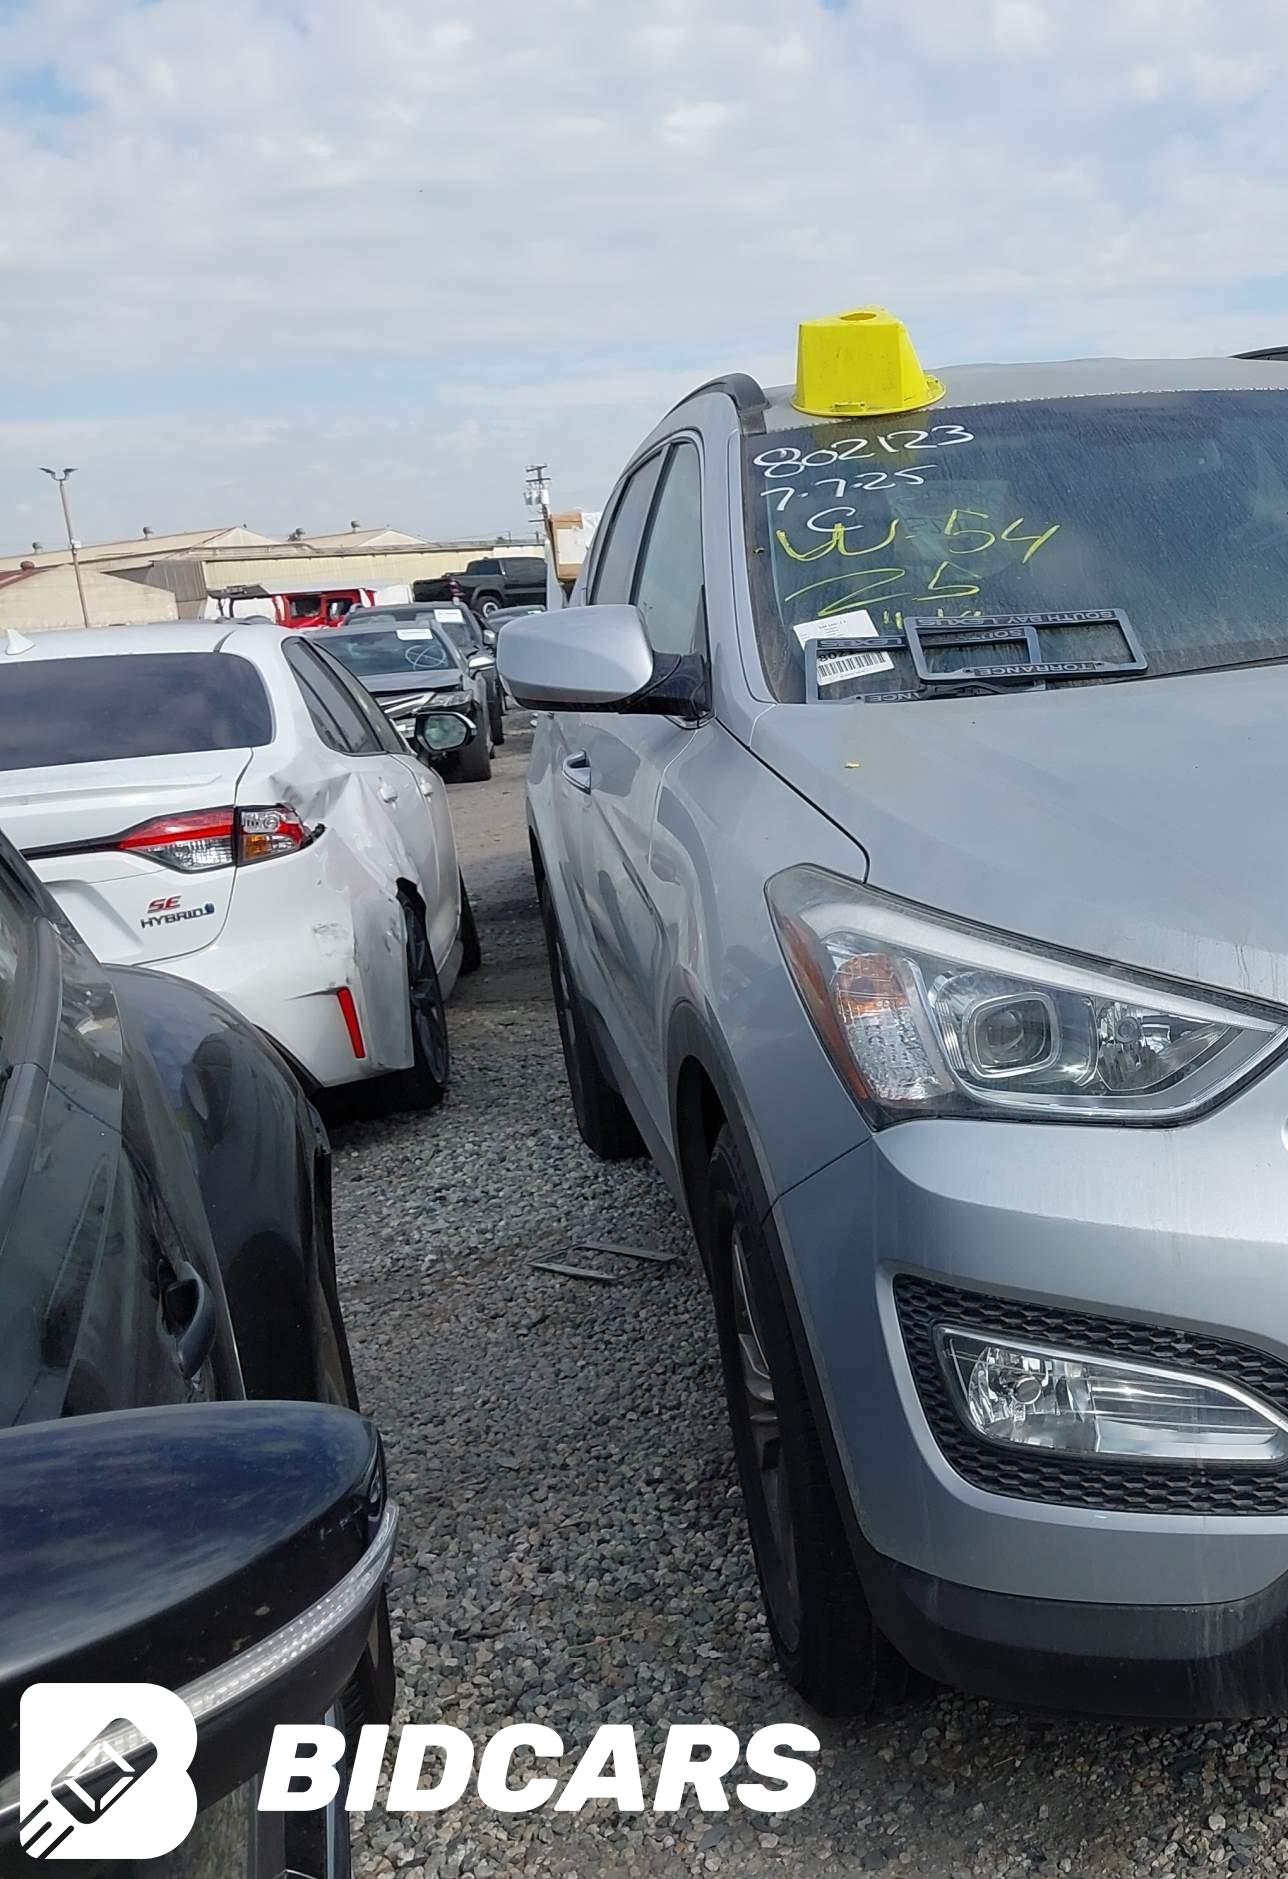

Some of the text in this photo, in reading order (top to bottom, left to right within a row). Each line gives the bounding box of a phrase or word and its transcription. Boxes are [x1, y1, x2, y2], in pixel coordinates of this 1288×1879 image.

[753, 425, 975, 479] 802123
[918, 617, 998, 626] LEXUS
[1007, 615, 1042, 624] BAY
[1047, 610, 1113, 622] SOUTH
[979, 662, 1092, 676] TORRANCE
[147, 895, 182, 913] SE
[140, 907, 205, 928] HYBRID
